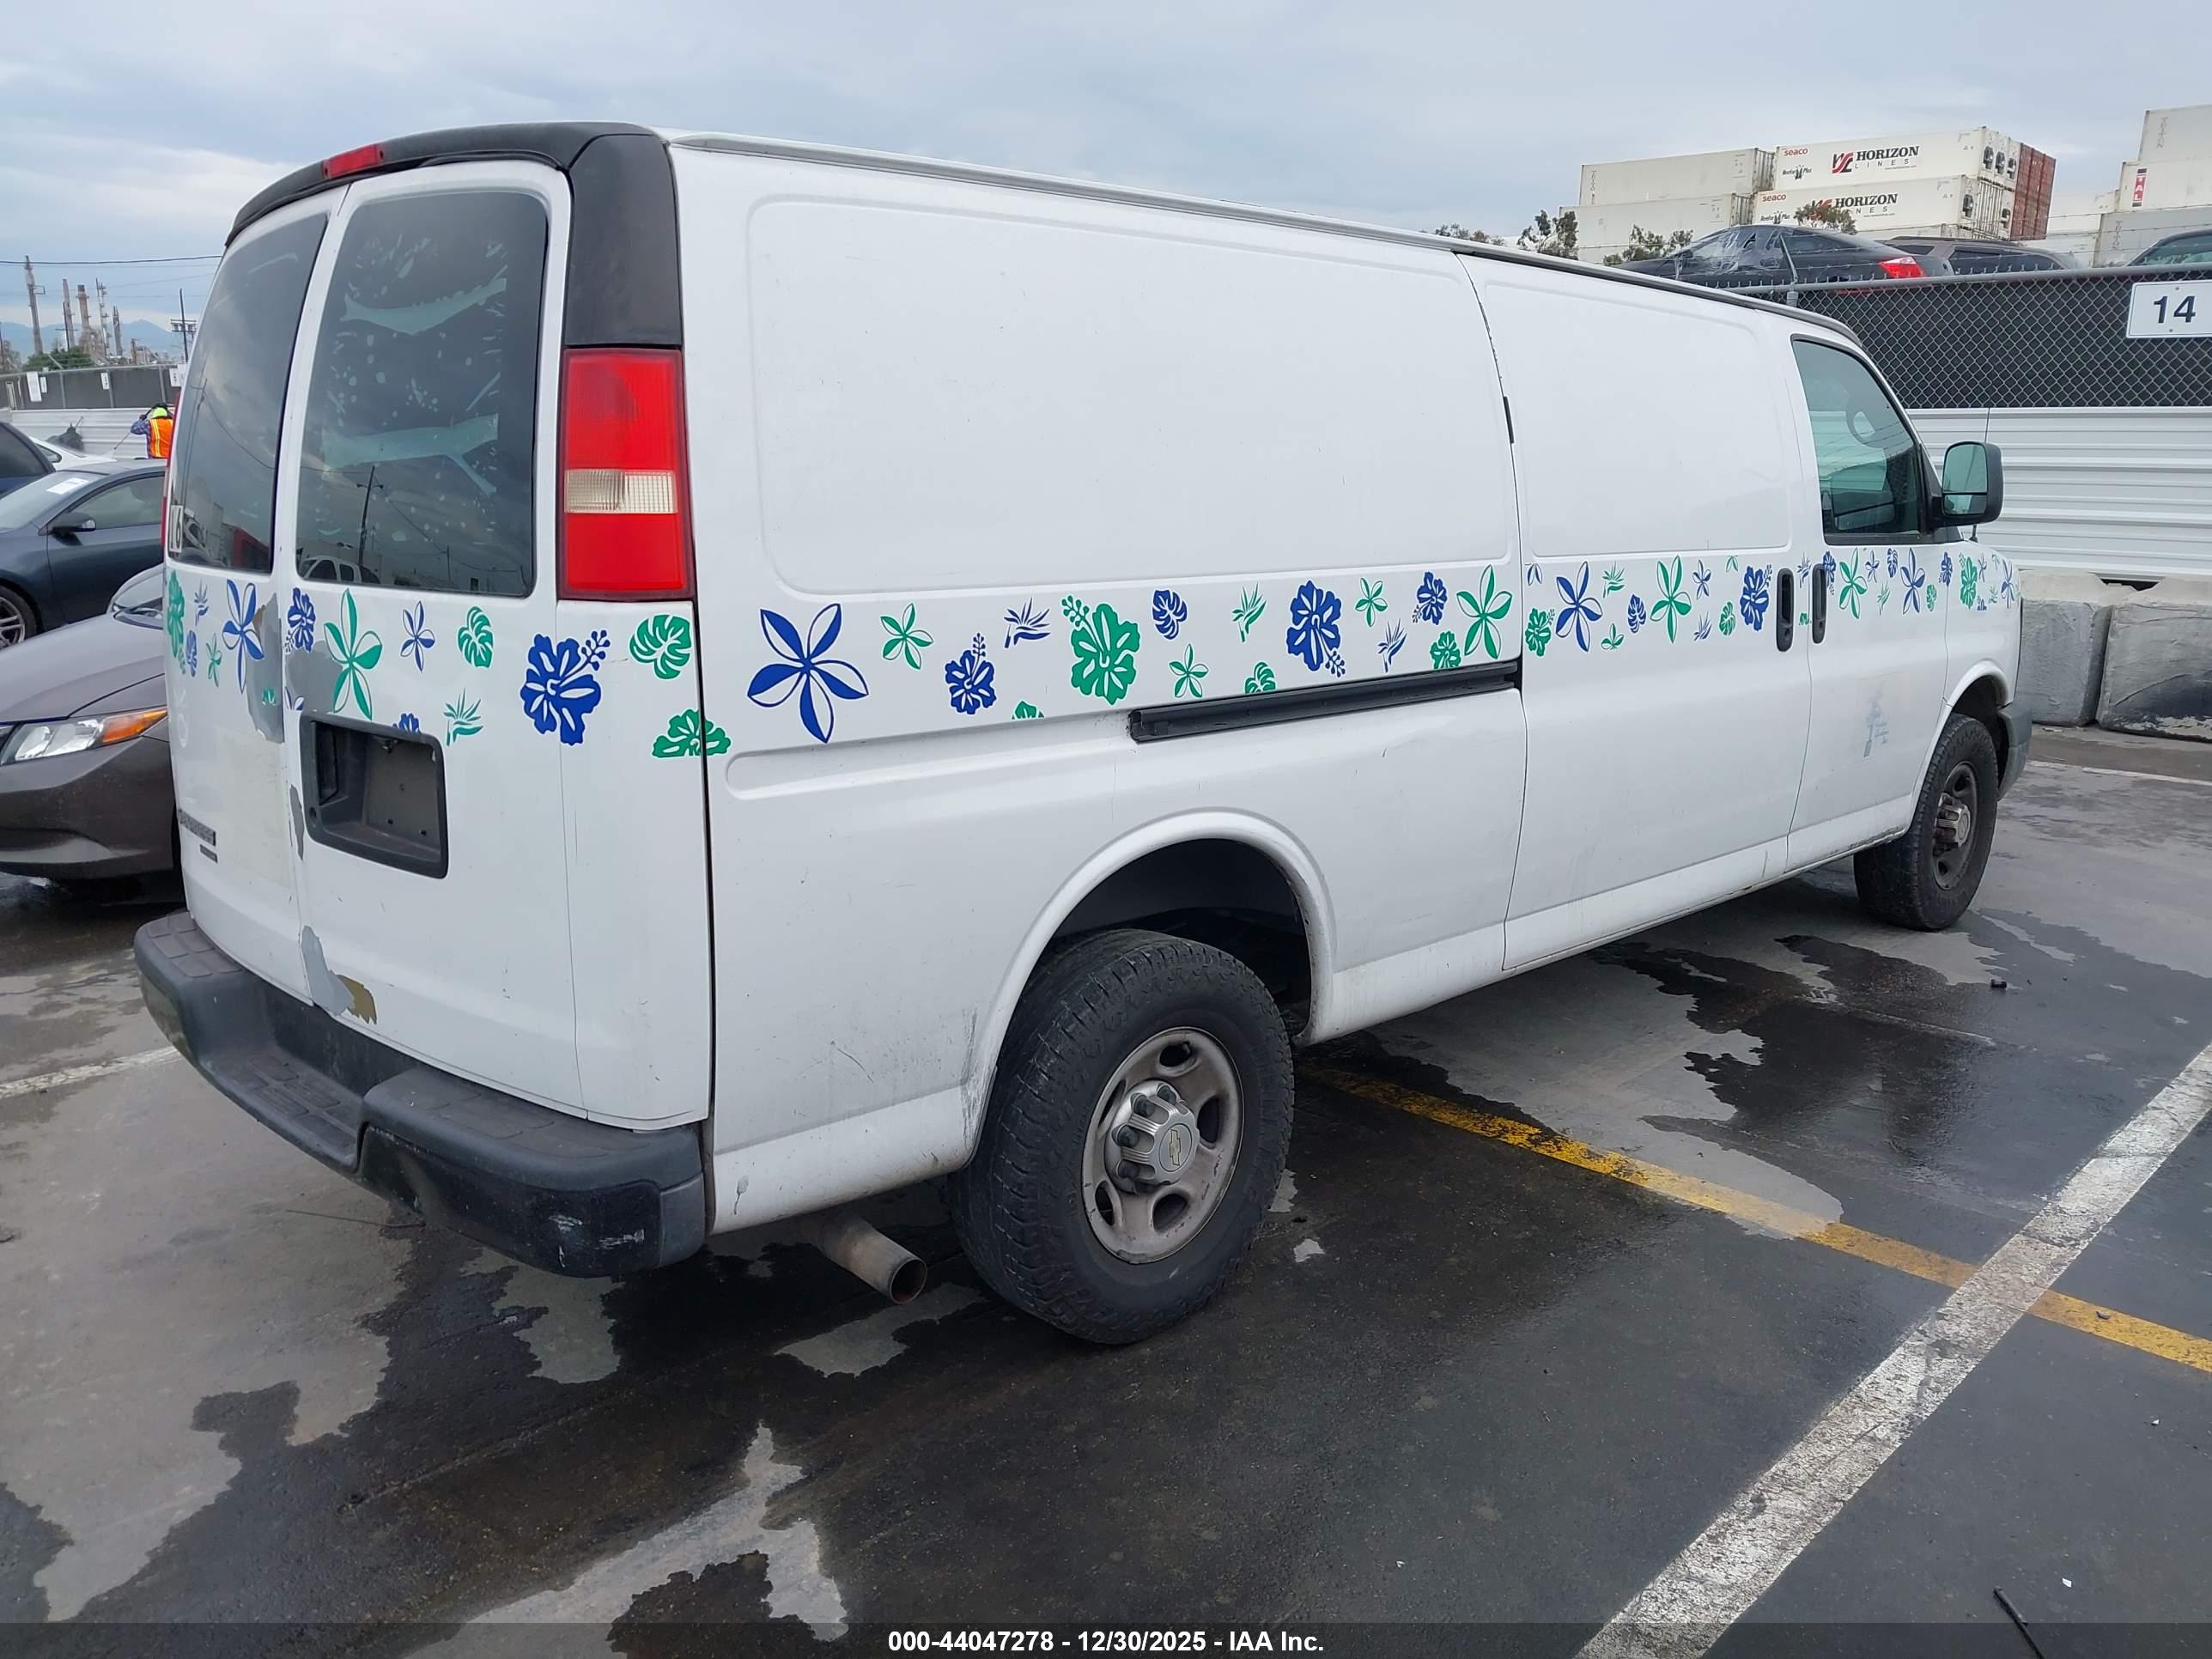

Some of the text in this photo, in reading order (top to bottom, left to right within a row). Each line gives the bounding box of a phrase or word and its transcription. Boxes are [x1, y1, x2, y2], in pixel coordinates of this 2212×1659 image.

[1784, 148, 1808, 156] seaco
[1856, 146, 1919, 161] HORIZON
[1855, 158, 1910, 169] LINES
[1834, 193, 1898, 208] HORIZON
[1856, 205, 1888, 214] NES
[2154, 296, 2197, 324] 14
